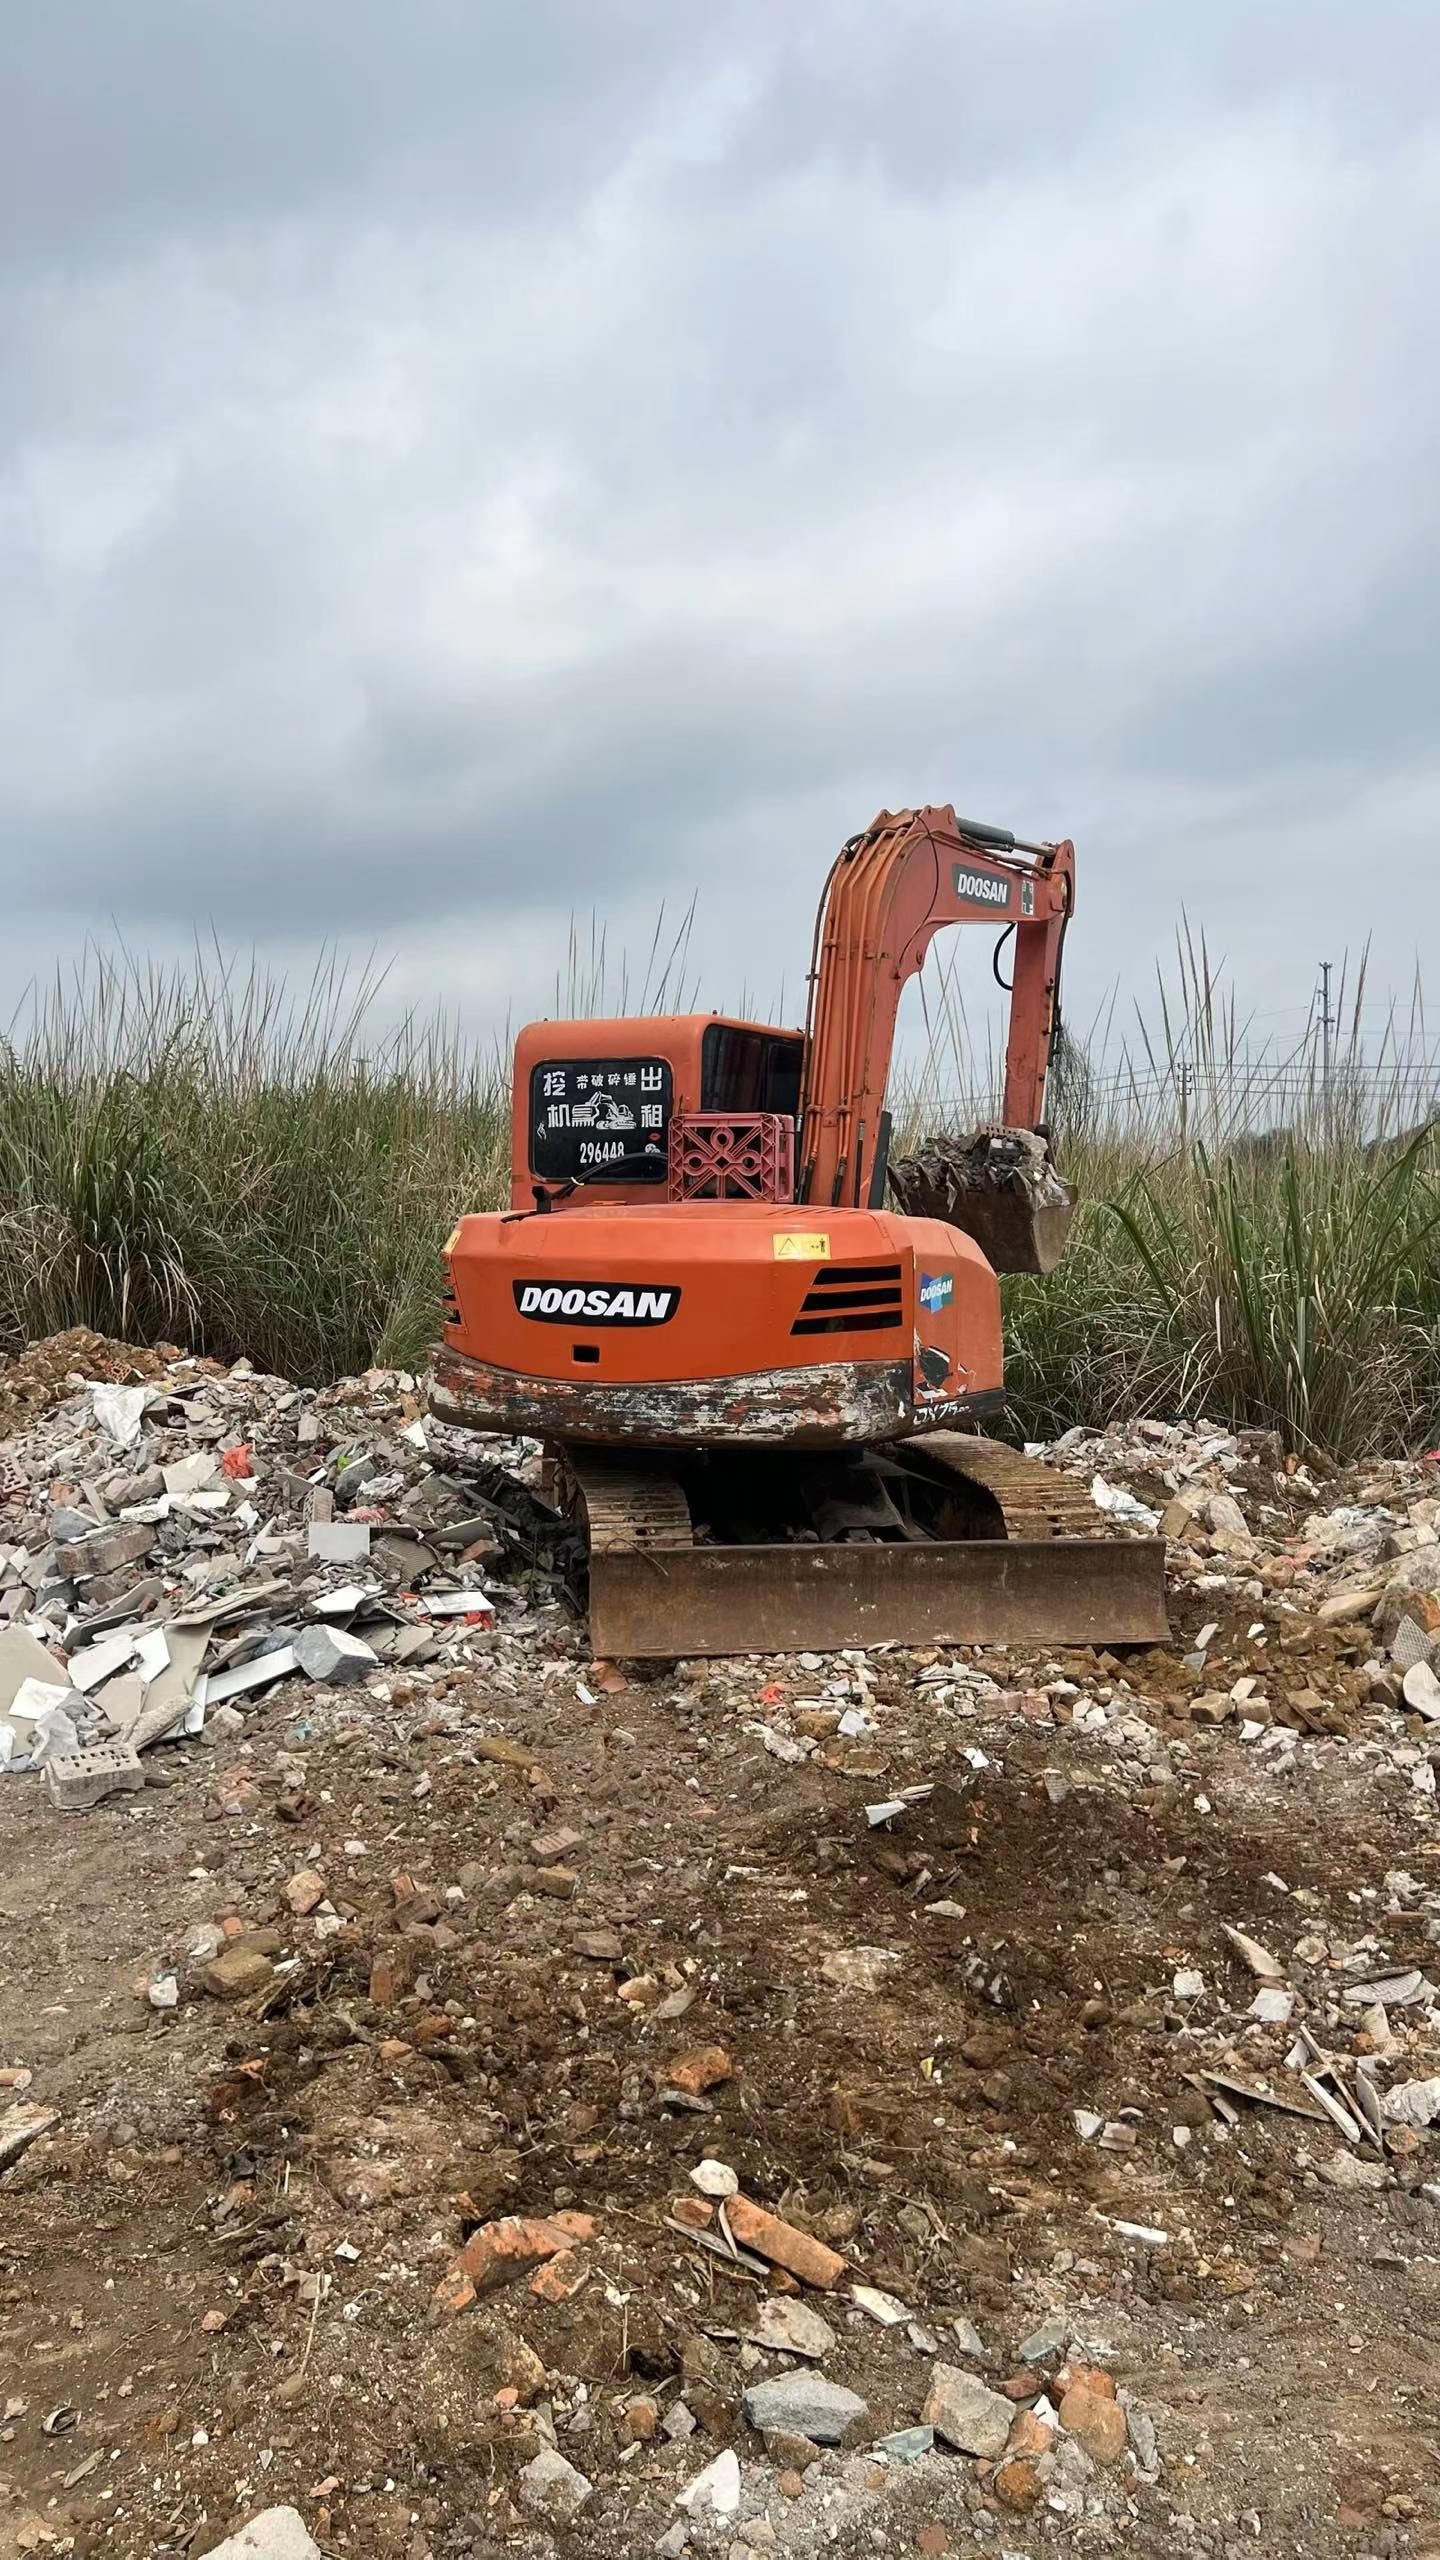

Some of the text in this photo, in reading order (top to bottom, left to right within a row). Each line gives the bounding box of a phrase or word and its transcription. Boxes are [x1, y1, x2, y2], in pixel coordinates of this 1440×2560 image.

[957, 873, 1008, 904] DOOSAN
[576, 1072, 637, 1090] 带破碎锤
[579, 1141, 625, 1164] 296448
[519, 1287, 672, 1319] DOOSAN
[920, 1279, 953, 1303] DOOSAN
